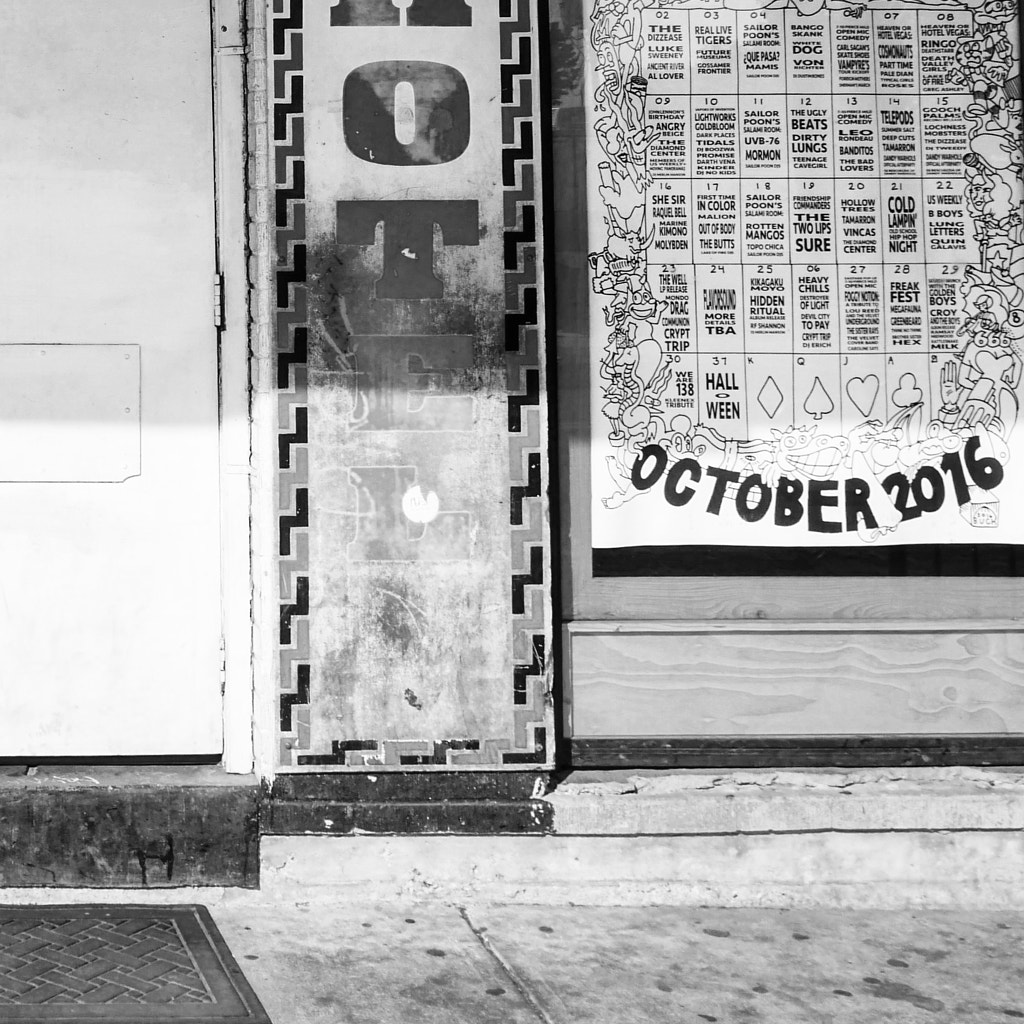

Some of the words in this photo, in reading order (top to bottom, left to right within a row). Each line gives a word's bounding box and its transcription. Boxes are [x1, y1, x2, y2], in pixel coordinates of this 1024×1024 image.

[656, 11, 669, 19] 02
[704, 11, 719, 19] 03
[937, 13, 954, 21] 08
[695, 26, 715, 34] REAL
[716, 26, 732, 34] LIVE
[696, 36, 732, 44] TIGERS
[921, 40, 956, 48] RINGO
[793, 46, 822, 54] DOG
[655, 97, 670, 105] 09
[847, 97, 857, 105] 13
[694, 113, 736, 121] LIGHTWORKS
[881, 110, 913, 125] TELEPODS
[656, 122, 685, 130] ANGRY
[792, 119, 828, 130] BEATS
[745, 137, 780, 145] UVB-76
[792, 143, 827, 153] LUNGS
[840, 146, 873, 155] BANDITOS
[746, 150, 781, 160] MORMON
[891, 183, 902, 191] 21
[936, 181, 953, 189] 22
[652, 195, 669, 204] SHE
[671, 195, 686, 204] SIR
[927, 195, 935, 204] US
[937, 195, 962, 204] WEEKLY
[697, 201, 705, 211] IN
[708, 201, 736, 211] COLOR
[888, 196, 915, 213] COLD
[653, 208, 673, 219] RAQUEL
[675, 207, 687, 217] BELL
[841, 216, 875, 224] TAMARRON
[659, 227, 687, 236] KIMONO
[699, 224, 710, 234] OUT
[711, 224, 719, 234] OF
[720, 223, 735, 234] BODY
[793, 223, 813, 234] TWO
[815, 223, 831, 234] LIPS
[843, 228, 876, 236] VINCAS
[930, 228, 964, 236] LETTERS
[746, 231, 784, 240] MANGOS
[655, 240, 688, 249] MOLYBDEN
[700, 239, 712, 249] THE
[714, 239, 735, 249] BUTTS
[796, 238, 831, 252] SURE
[889, 241, 917, 252] NIGHT
[757, 265, 773, 273] 25
[850, 266, 865, 274] 27
[894, 265, 910, 274] 28
[659, 274, 670, 285] THE
[672, 274, 687, 285] WELL
[798, 284, 829, 292] CHILLS
[890, 282, 919, 290] FREAK
[750, 296, 784, 306] HIDDEN
[890, 291, 920, 303] FEST
[930, 297, 956, 305] BOYS
[670, 301, 688, 315] DRAG
[800, 301, 809, 309] OF
[811, 301, 829, 309] LIGHT
[1012, 312, 1020, 323] 8
[801, 321, 813, 329] TO
[815, 321, 830, 329] PAY
[664, 329, 690, 339] CRYPT
[705, 326, 736, 335] TBA
[665, 341, 690, 351] TRIP
[797, 357, 805, 366] Q
[843, 357, 848, 365] J
[888, 356, 894, 365] A
[706, 373, 739, 390] HALL
[676, 383, 694, 396] 138
[706, 402, 740, 419] WEEN
[631, 444, 880, 533] OCTOBER
[882, 436, 1004, 521] 2016
